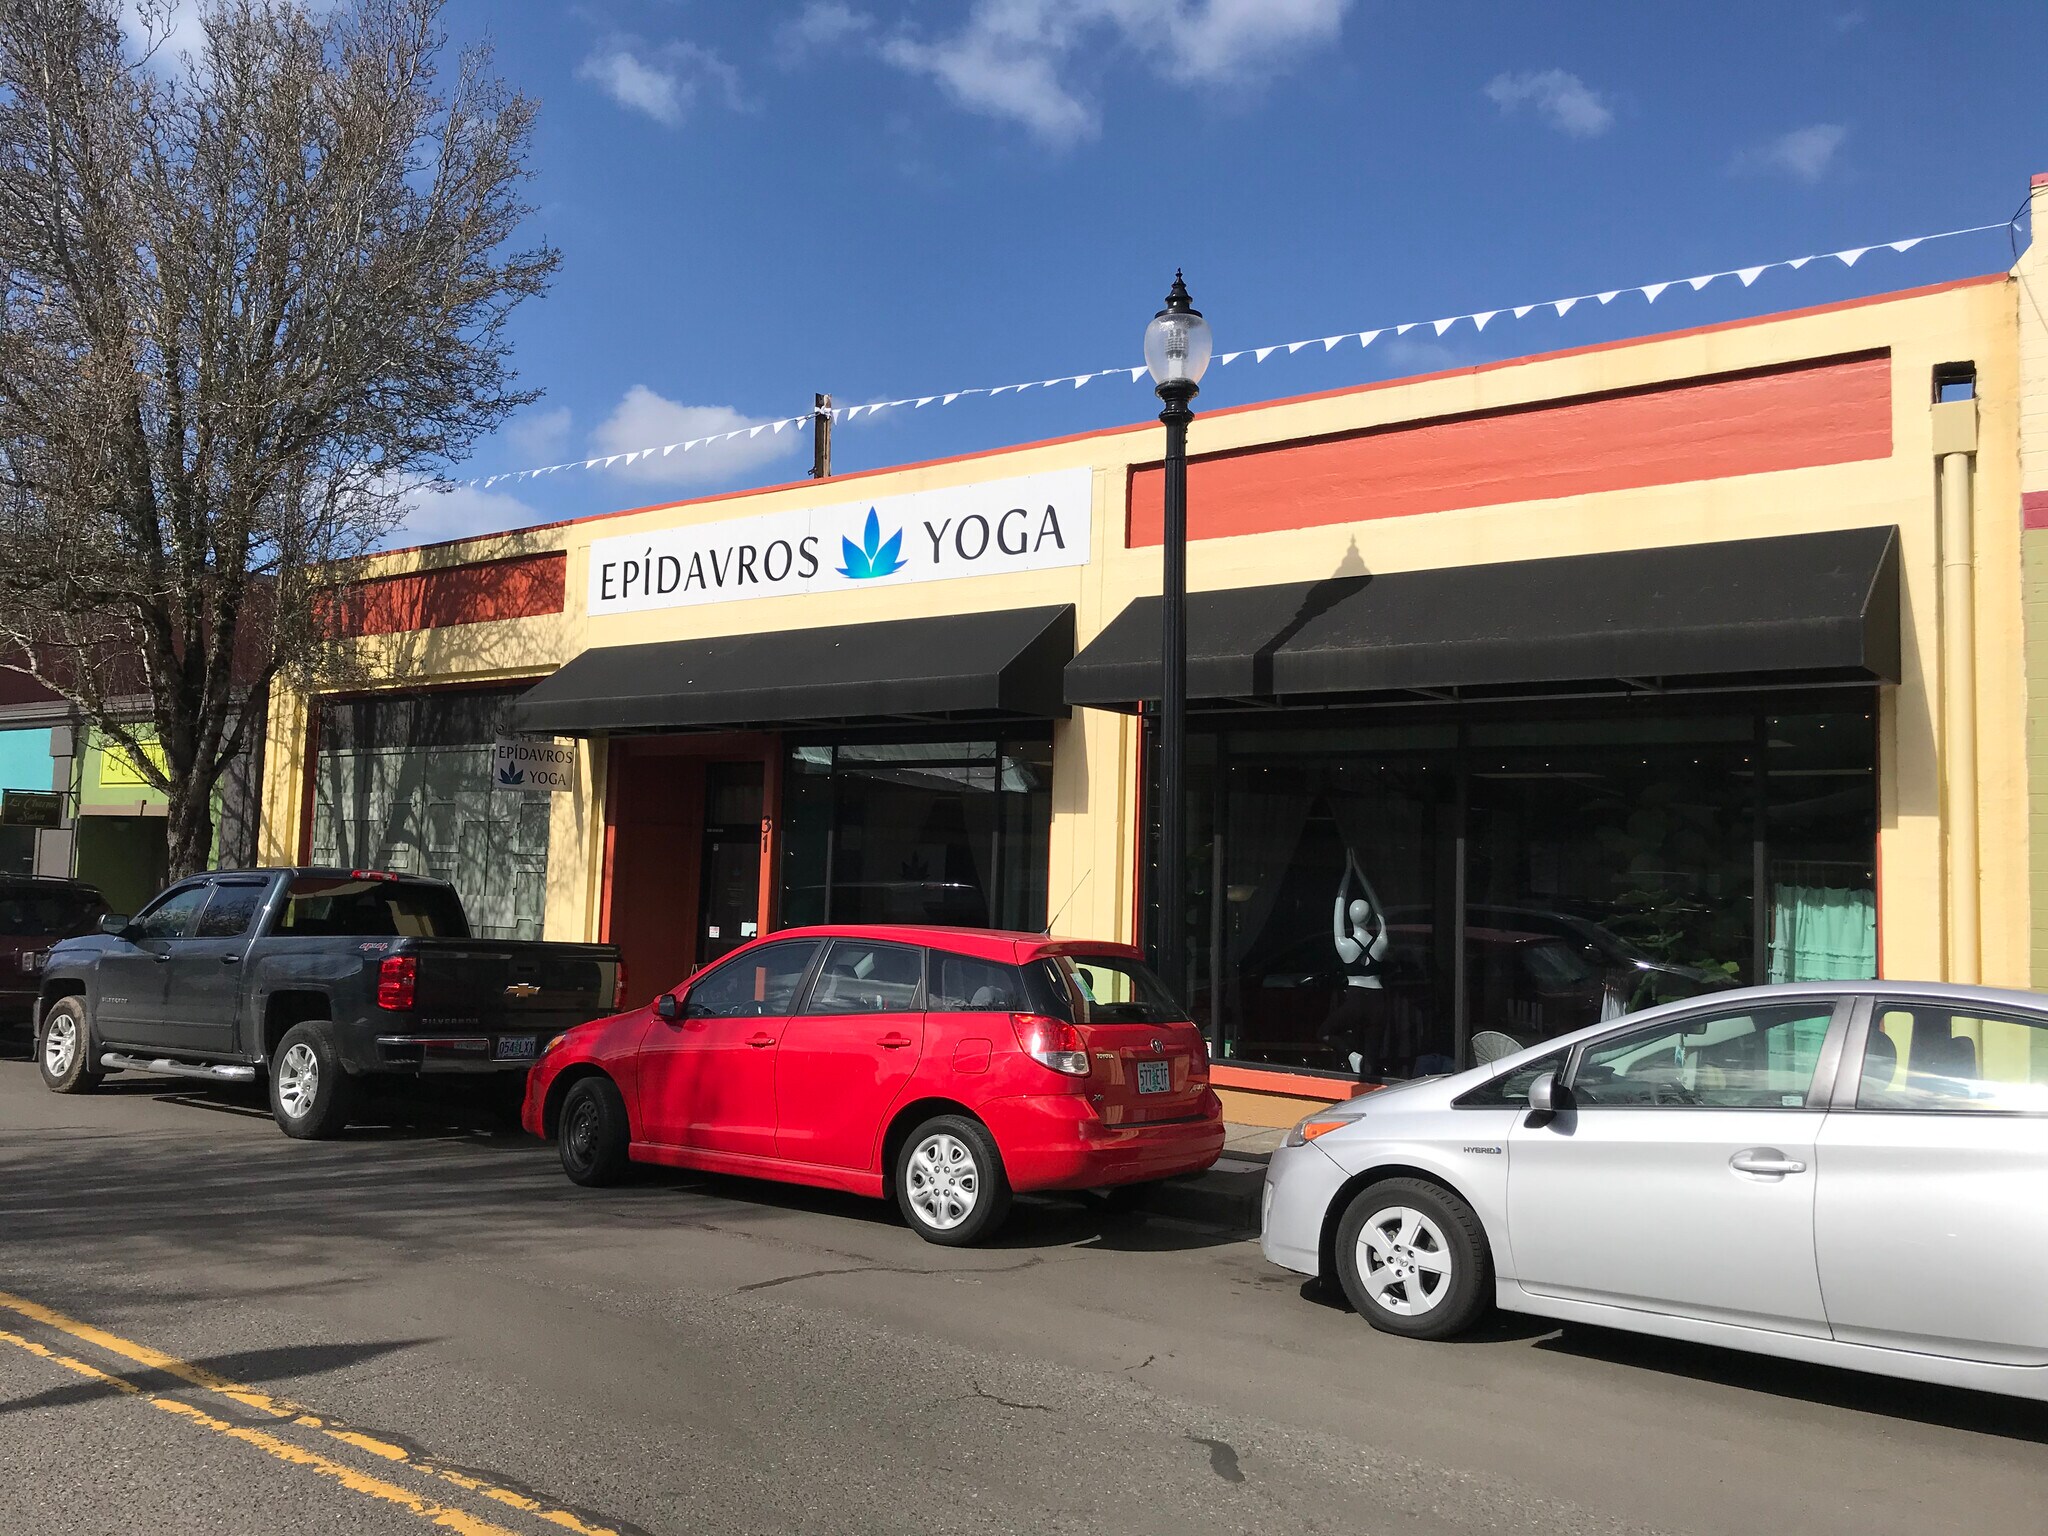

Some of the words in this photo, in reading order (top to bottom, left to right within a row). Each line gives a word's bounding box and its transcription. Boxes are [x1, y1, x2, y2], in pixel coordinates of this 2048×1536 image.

[601, 536, 819, 600] EPÍDAVROS
[923, 504, 1066, 564] YOGA
[499, 744, 573, 764] EPÍDAVROS
[529, 771, 566, 786] YOGA
[1463, 1146, 1496, 1155] HYBRID
